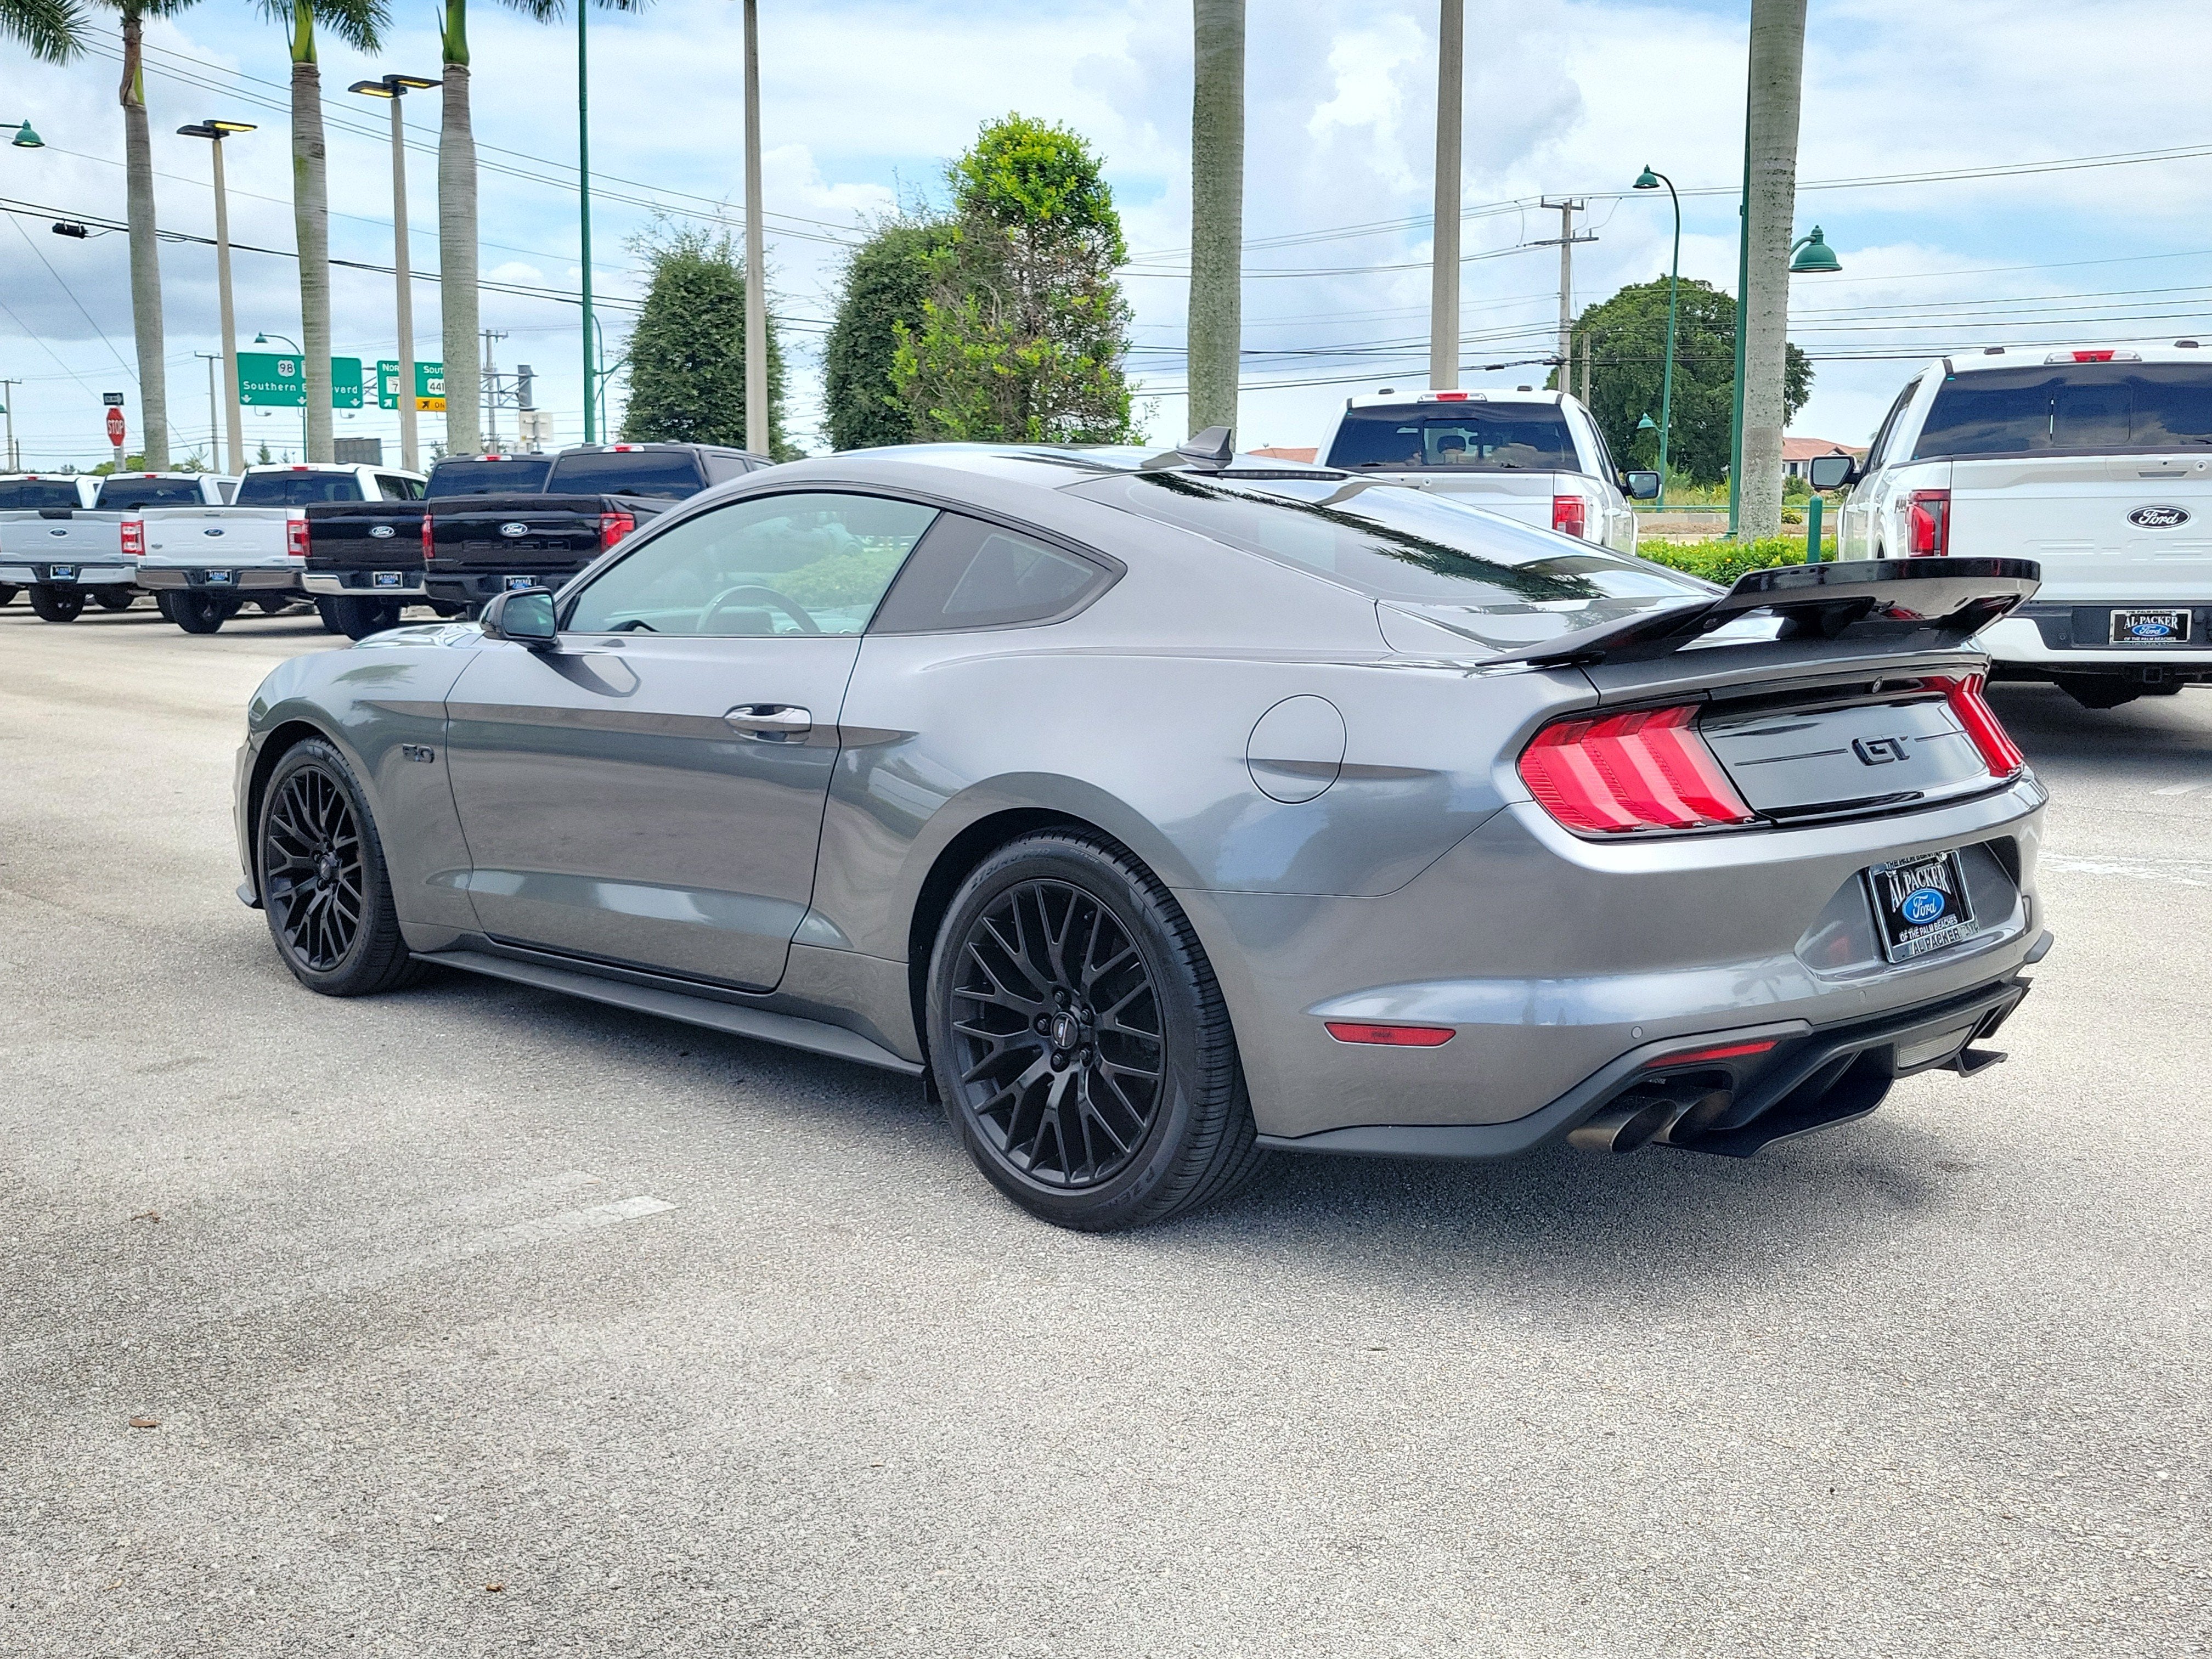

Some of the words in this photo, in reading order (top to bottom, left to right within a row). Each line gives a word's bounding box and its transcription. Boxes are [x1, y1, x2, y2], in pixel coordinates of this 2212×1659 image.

[279, 363, 293, 373] 98
[382, 363, 399, 372] NOR
[423, 365, 444, 374] SOUT
[242, 381, 296, 391] Southern
[392, 383, 398, 392] 7
[429, 382, 444, 391] 441
[108, 419, 123, 435] STOP
[2138, 509, 2179, 524] Ford
[2124, 616, 2138, 630] AL
[2140, 616, 2179, 630] PACKER
[2139, 625, 2162, 635] Ford
[1851, 735, 1911, 766] GT
[1889, 874, 1906, 913] AL
[1904, 863, 1951, 895] PACKER
[1912, 894, 1937, 918] Ford
[1900, 931, 1909, 942] OF
[1909, 928, 1920, 939] THE
[1920, 924, 1934, 936] PALM
[1934, 916, 1958, 931] BEACHES
[1912, 940, 1925, 955] AL
[1925, 928, 1961, 950] PACKER
